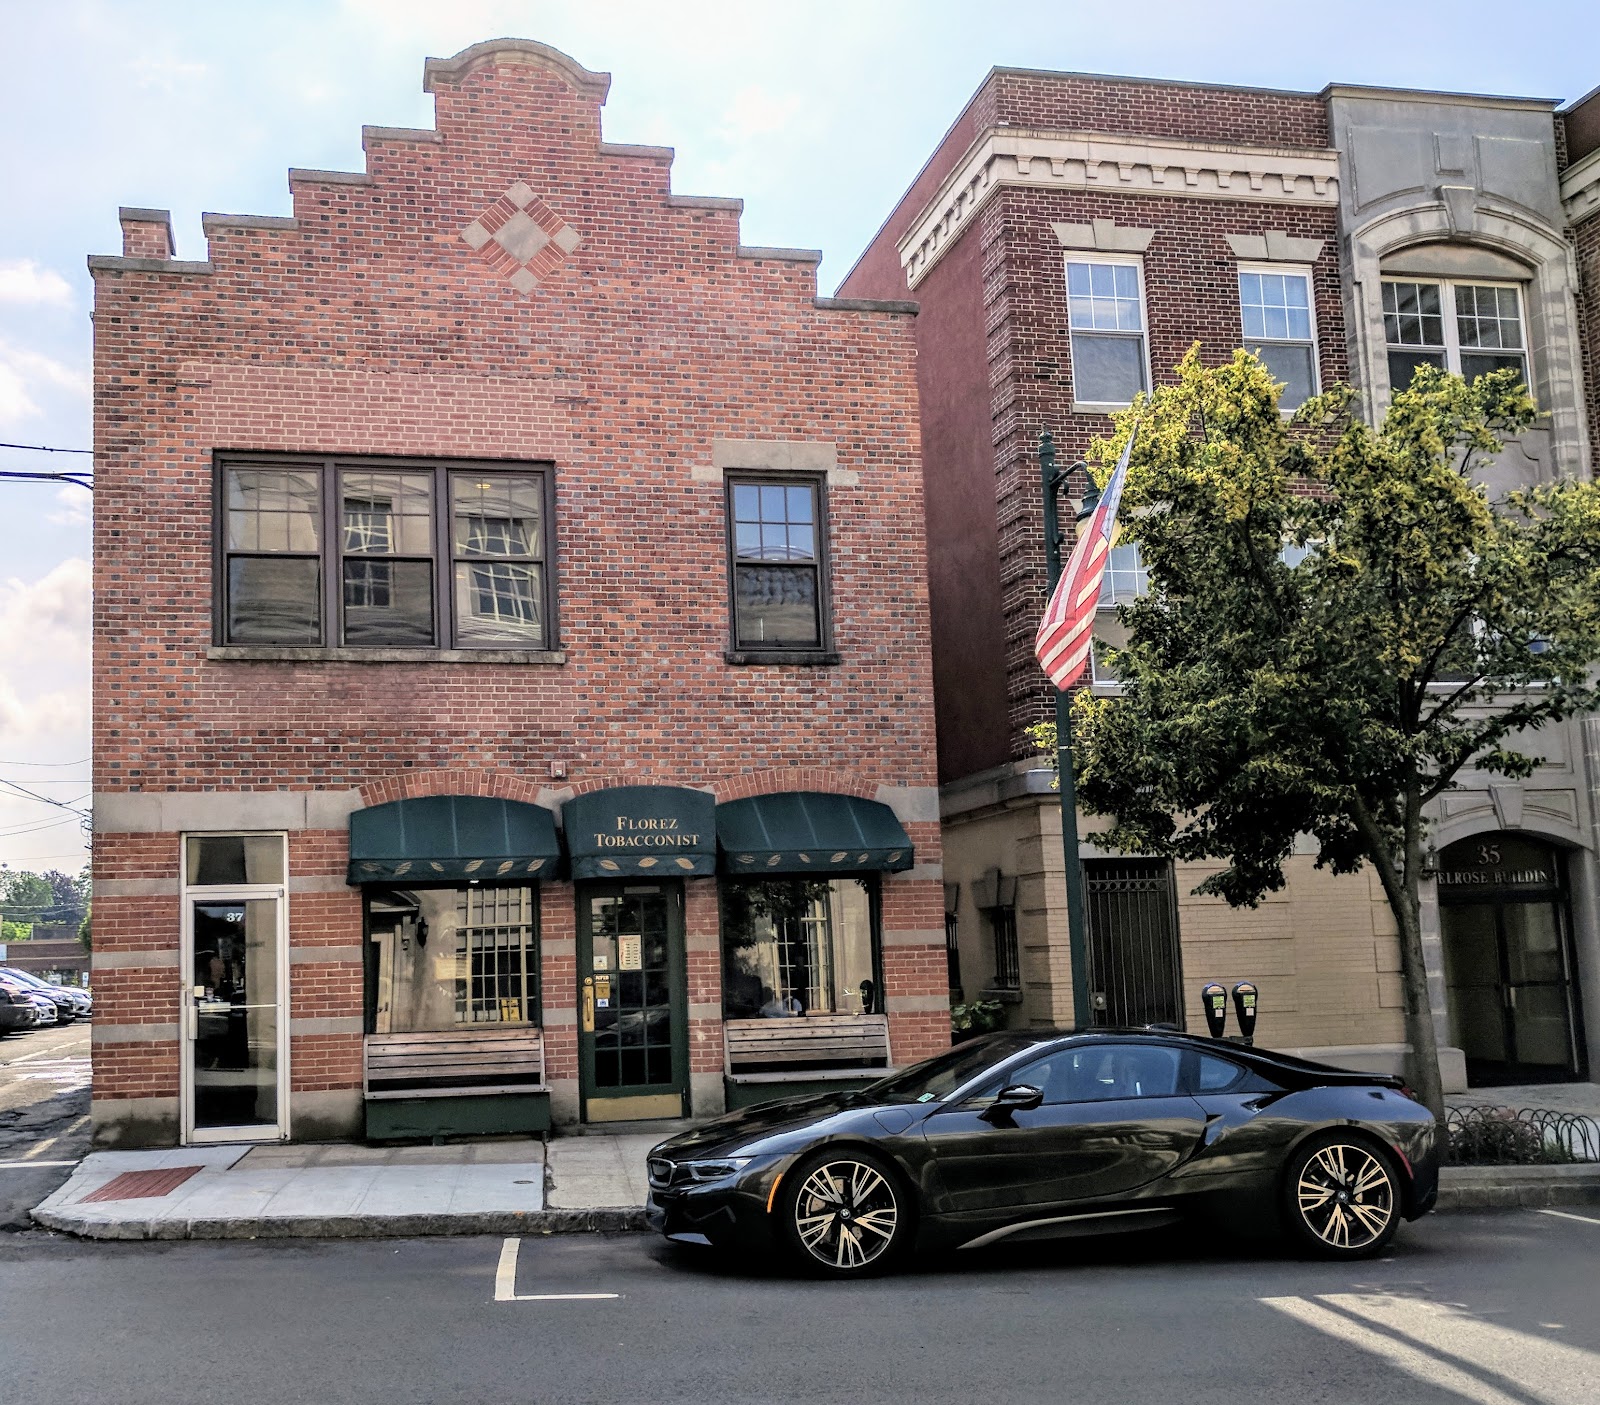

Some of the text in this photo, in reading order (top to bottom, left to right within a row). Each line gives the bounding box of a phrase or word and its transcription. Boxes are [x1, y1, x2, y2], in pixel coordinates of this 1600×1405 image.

[616, 816, 679, 830] FLOREZ
[594, 833, 700, 847] TOBACCONIST
[1477, 844, 1501, 865] 35
[1437, 869, 1548, 885] ELROSE BUILDIN
[226, 912, 244, 922] 37
